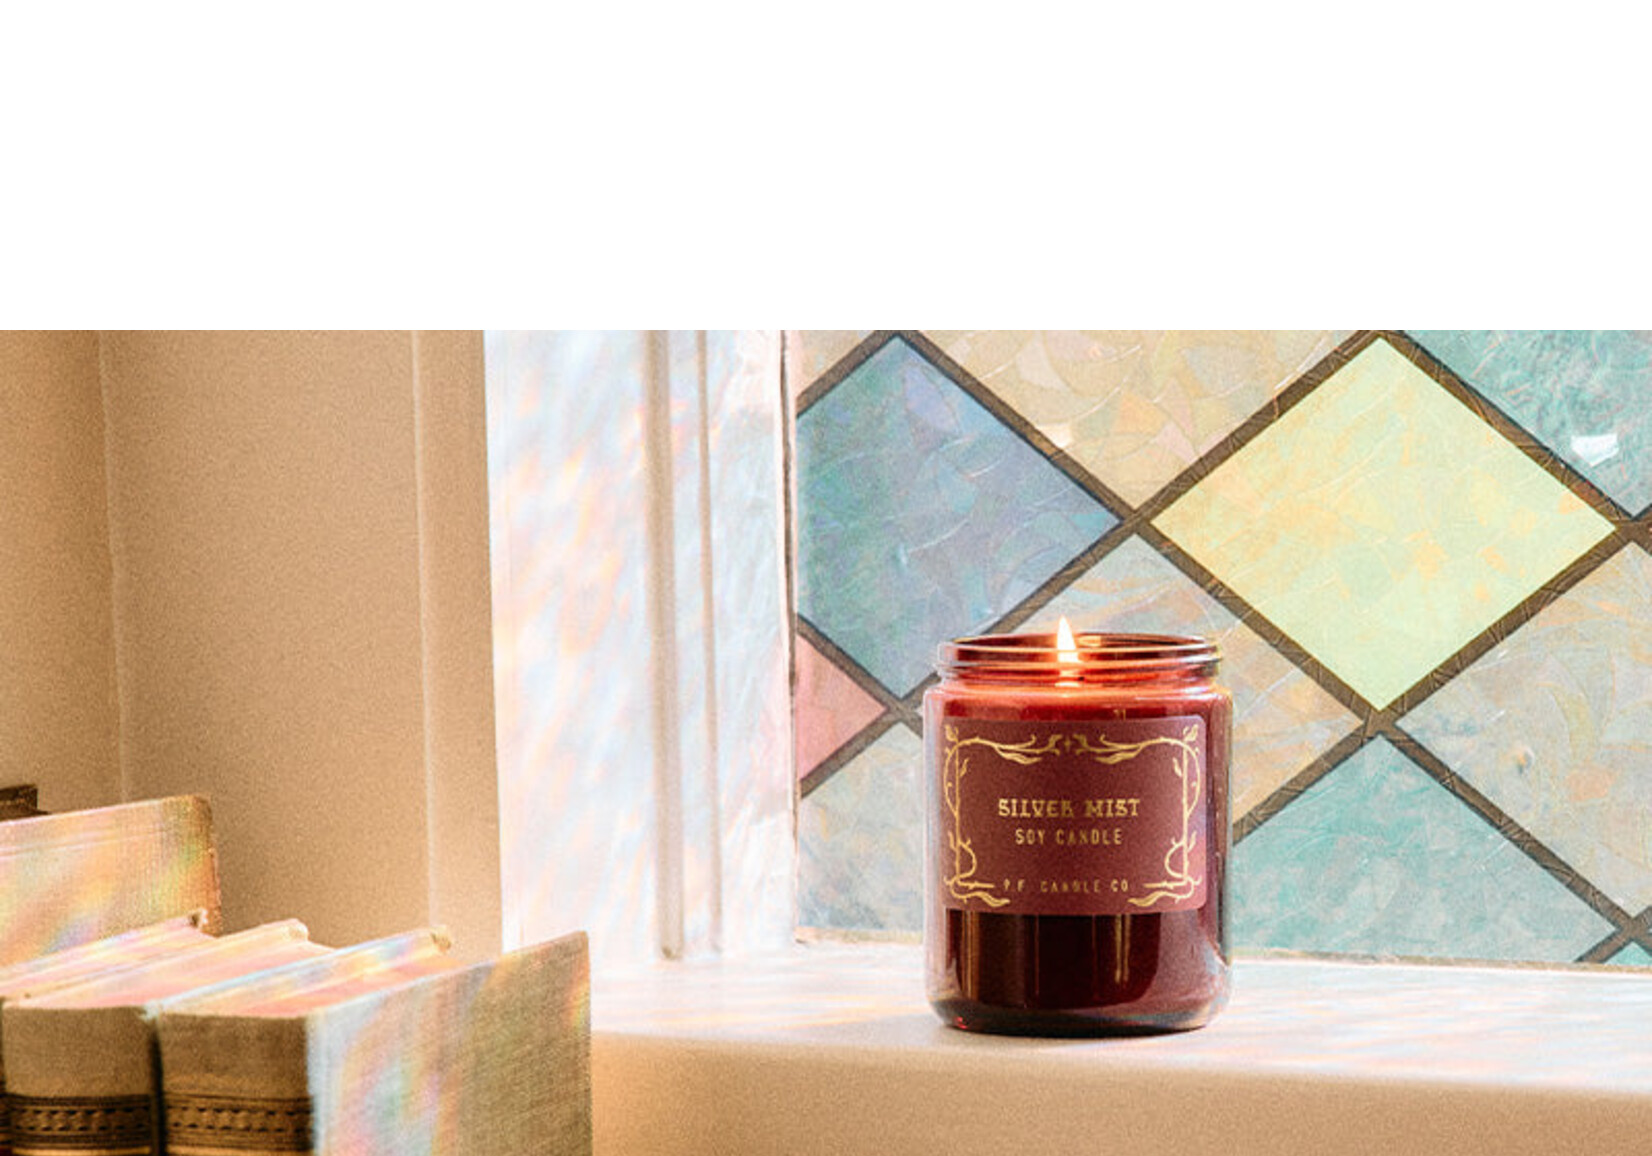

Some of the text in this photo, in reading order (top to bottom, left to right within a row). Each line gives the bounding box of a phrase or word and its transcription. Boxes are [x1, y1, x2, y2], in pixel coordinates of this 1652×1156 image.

[998, 797, 1140, 818] SILVER MIST
[1015, 828, 1122, 845] SOY CANDLE
